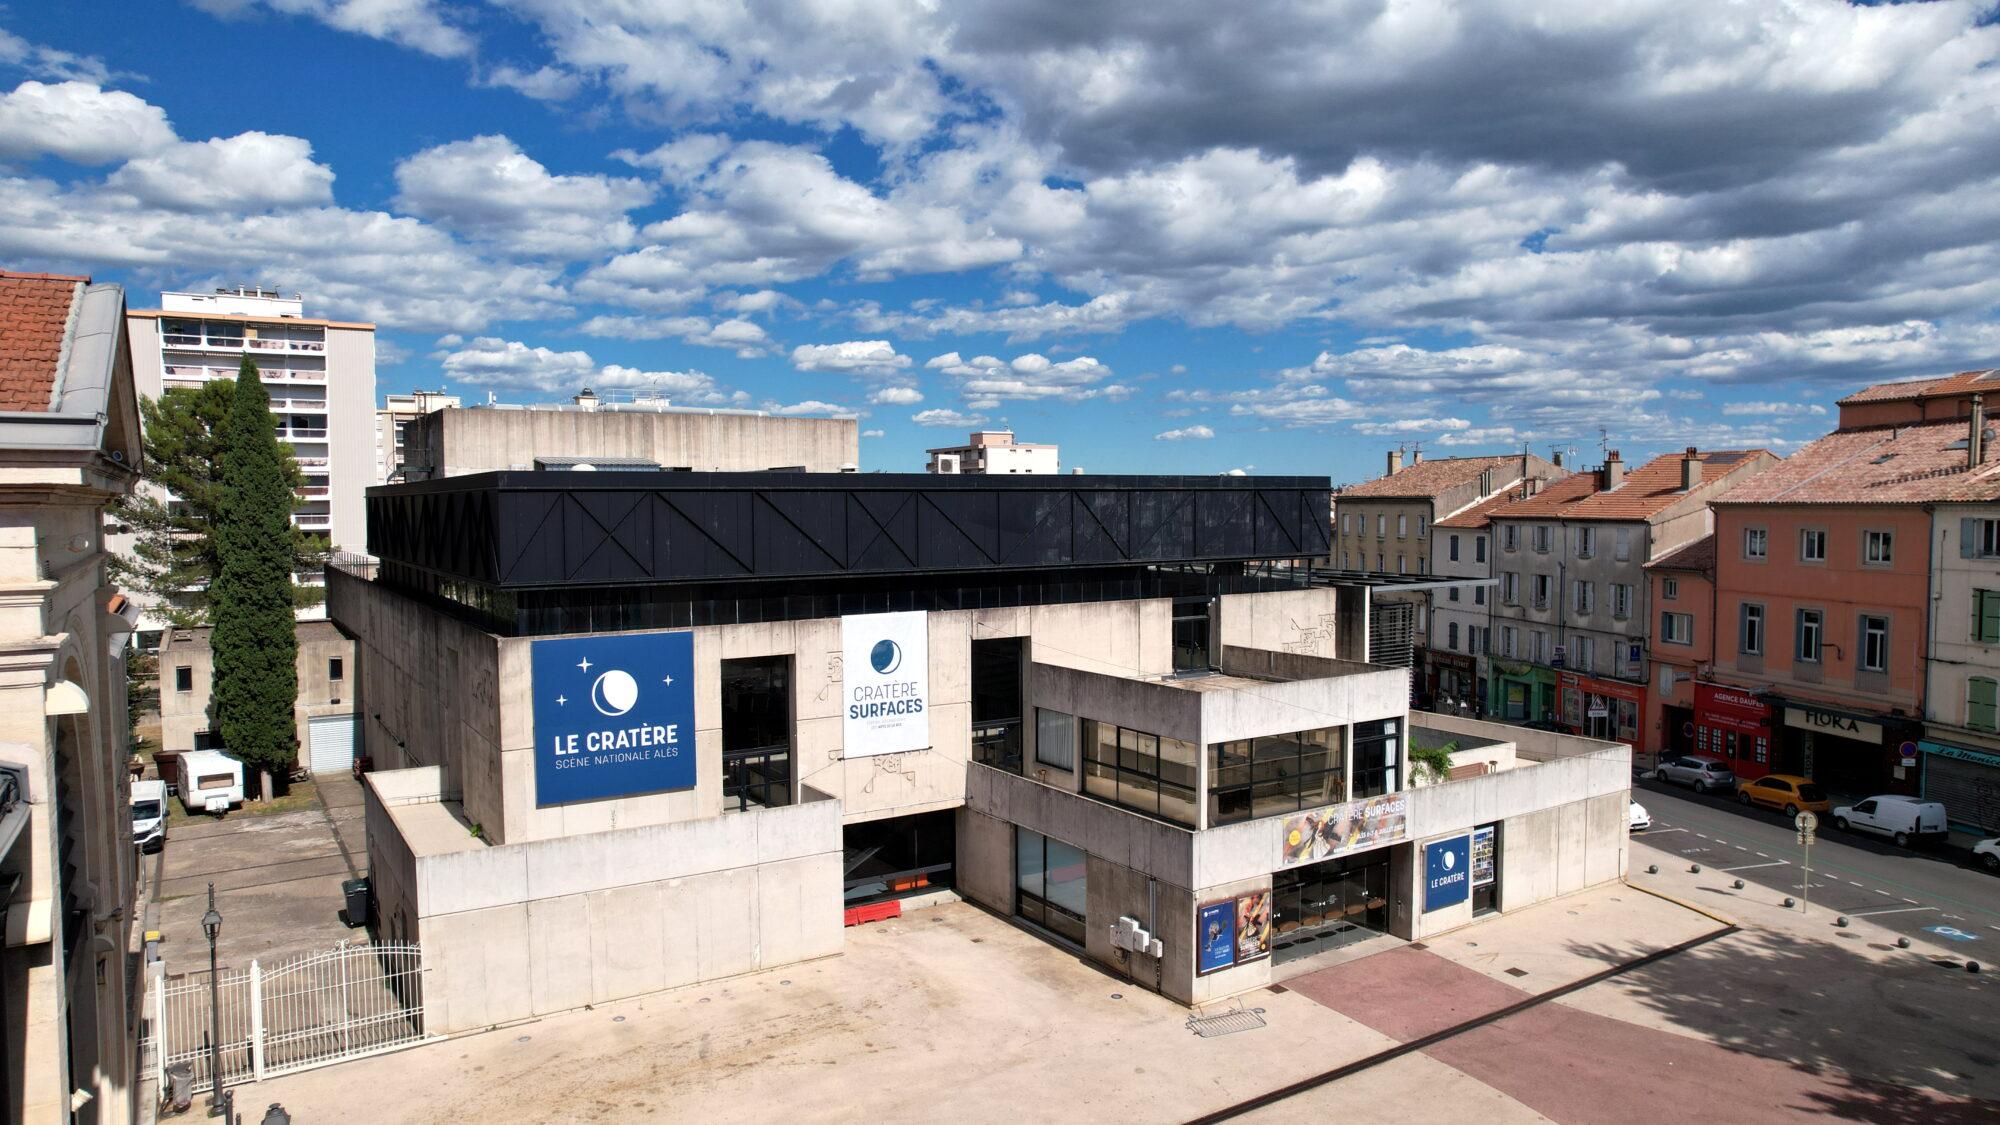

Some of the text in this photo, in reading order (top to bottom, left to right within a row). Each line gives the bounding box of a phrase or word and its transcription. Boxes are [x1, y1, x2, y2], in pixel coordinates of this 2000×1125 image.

[854, 680, 918, 701] CRATÈRE
[1714, 692, 1739, 703] AGENCE
[850, 698, 923, 719] SURFACES
[1806, 709, 1860, 733] FLORA
[555, 723, 678, 755] LE CRATÈRE
[555, 747, 678, 770] SCÈNE NATIONALE ALÈS
[1957, 751, 2000, 766] Monic
[1365, 799, 1405, 818] SURFACES
[1431, 872, 1465, 888] LE CRATÈRE
